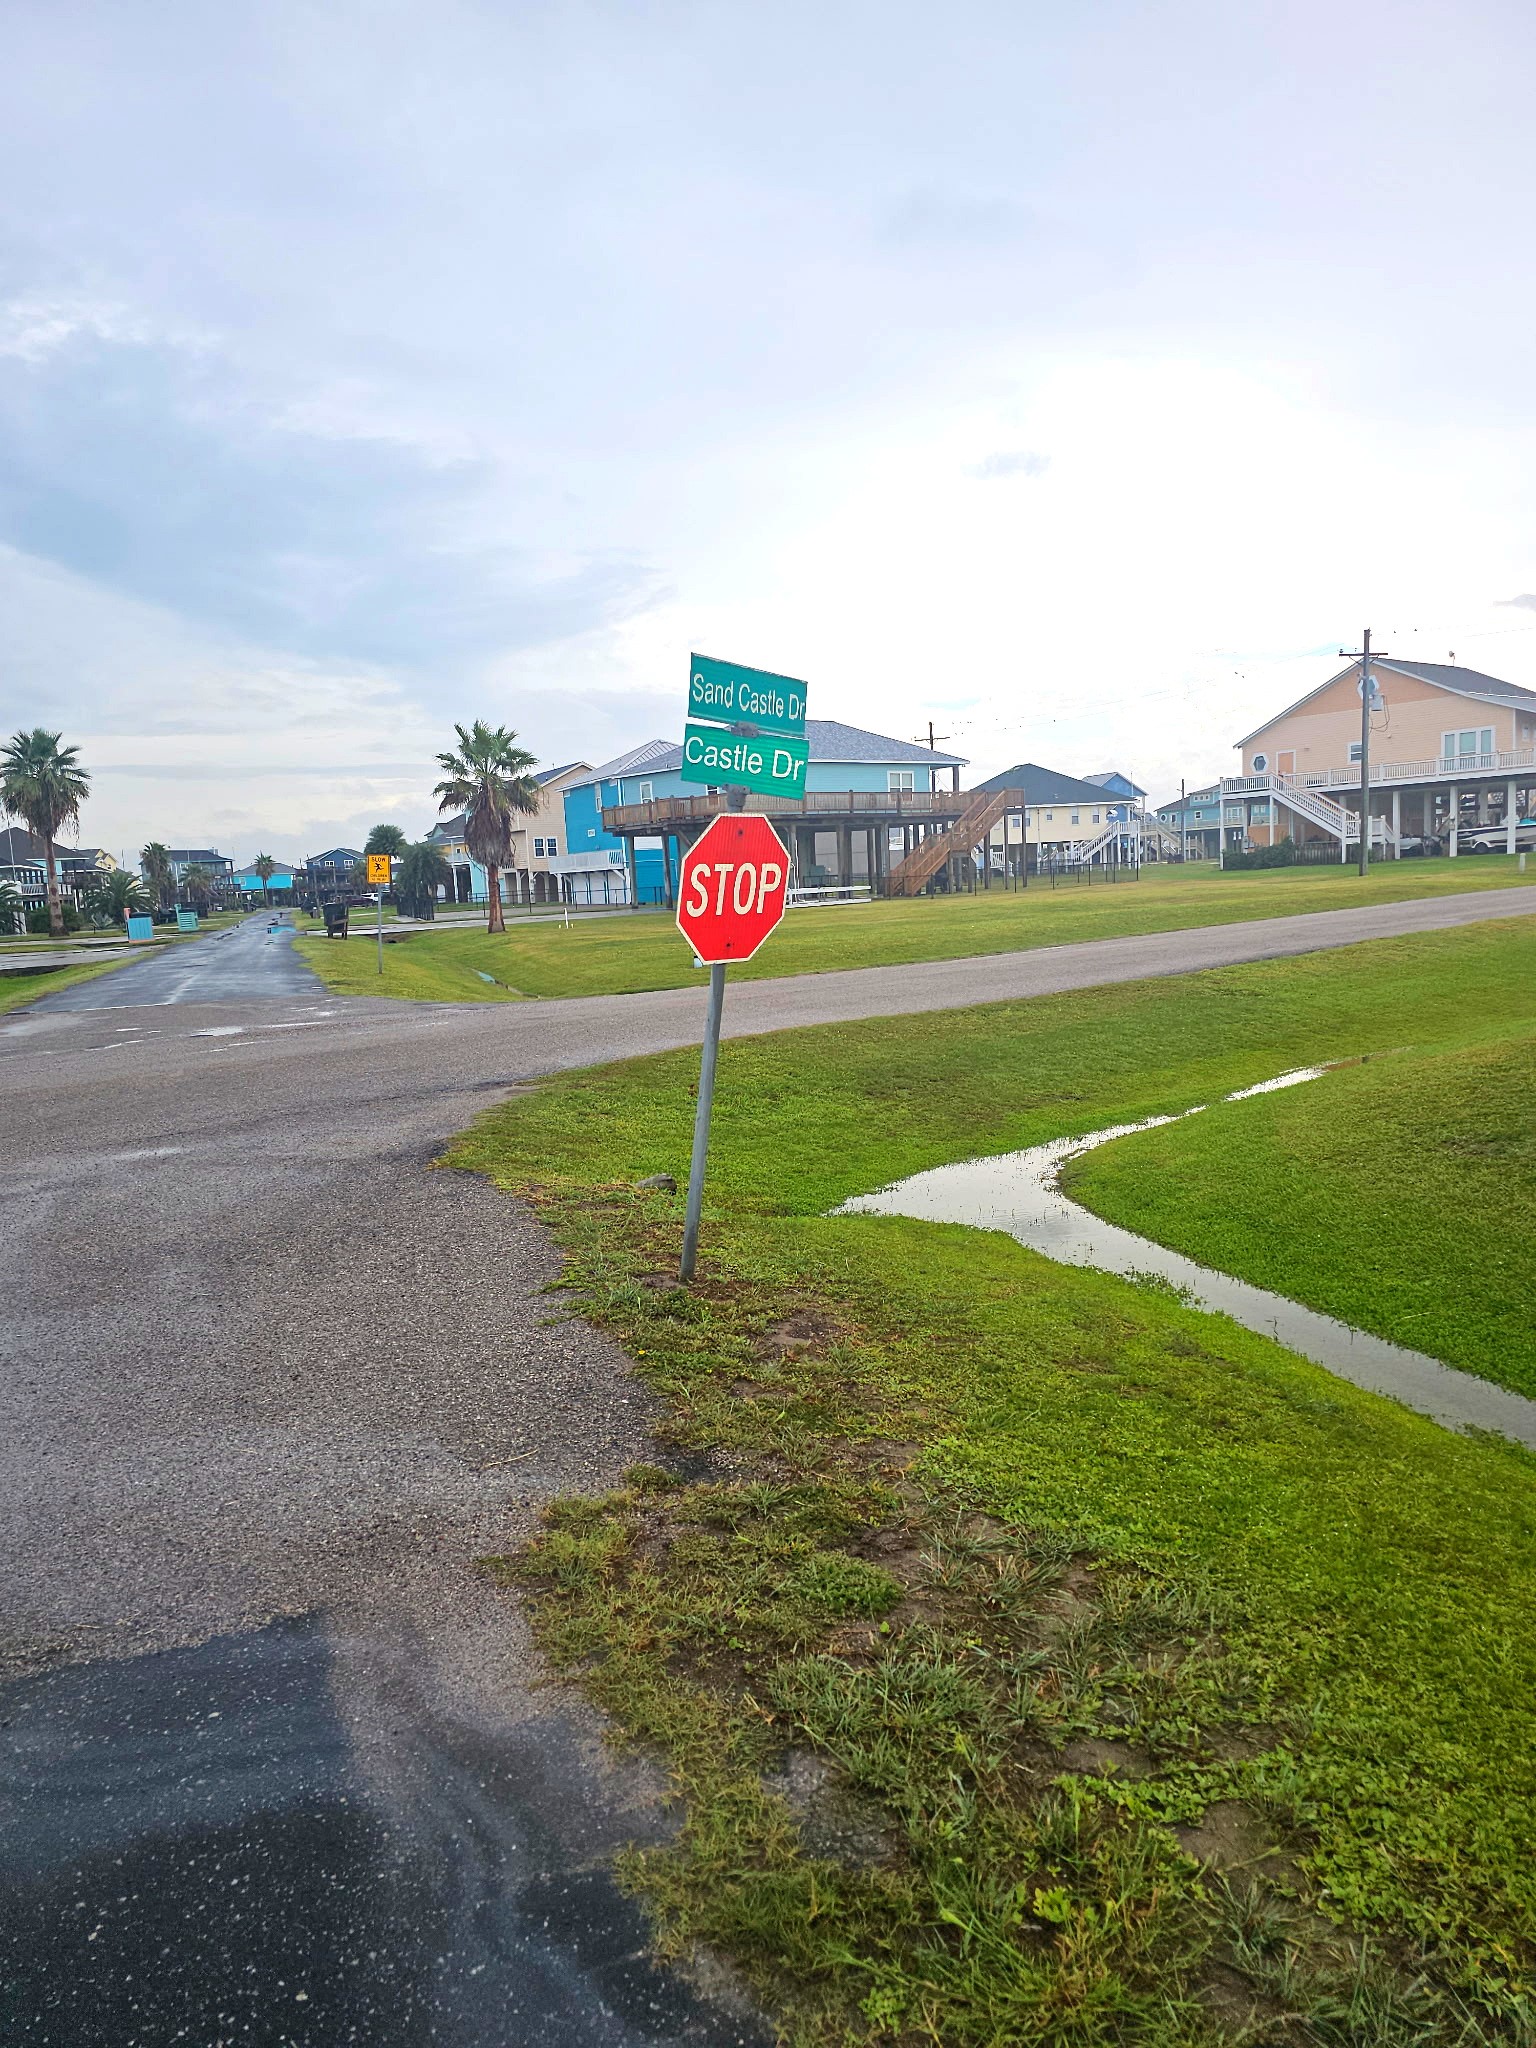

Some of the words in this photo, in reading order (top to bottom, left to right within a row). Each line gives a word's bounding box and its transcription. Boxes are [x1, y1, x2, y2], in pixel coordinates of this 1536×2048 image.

[692, 673, 733, 709] Sand
[738, 683, 784, 717] Castle
[788, 693, 805, 721] Dr
[685, 736, 763, 775] Castle
[772, 749, 805, 781] Dr
[686, 862, 782, 918] STOP
